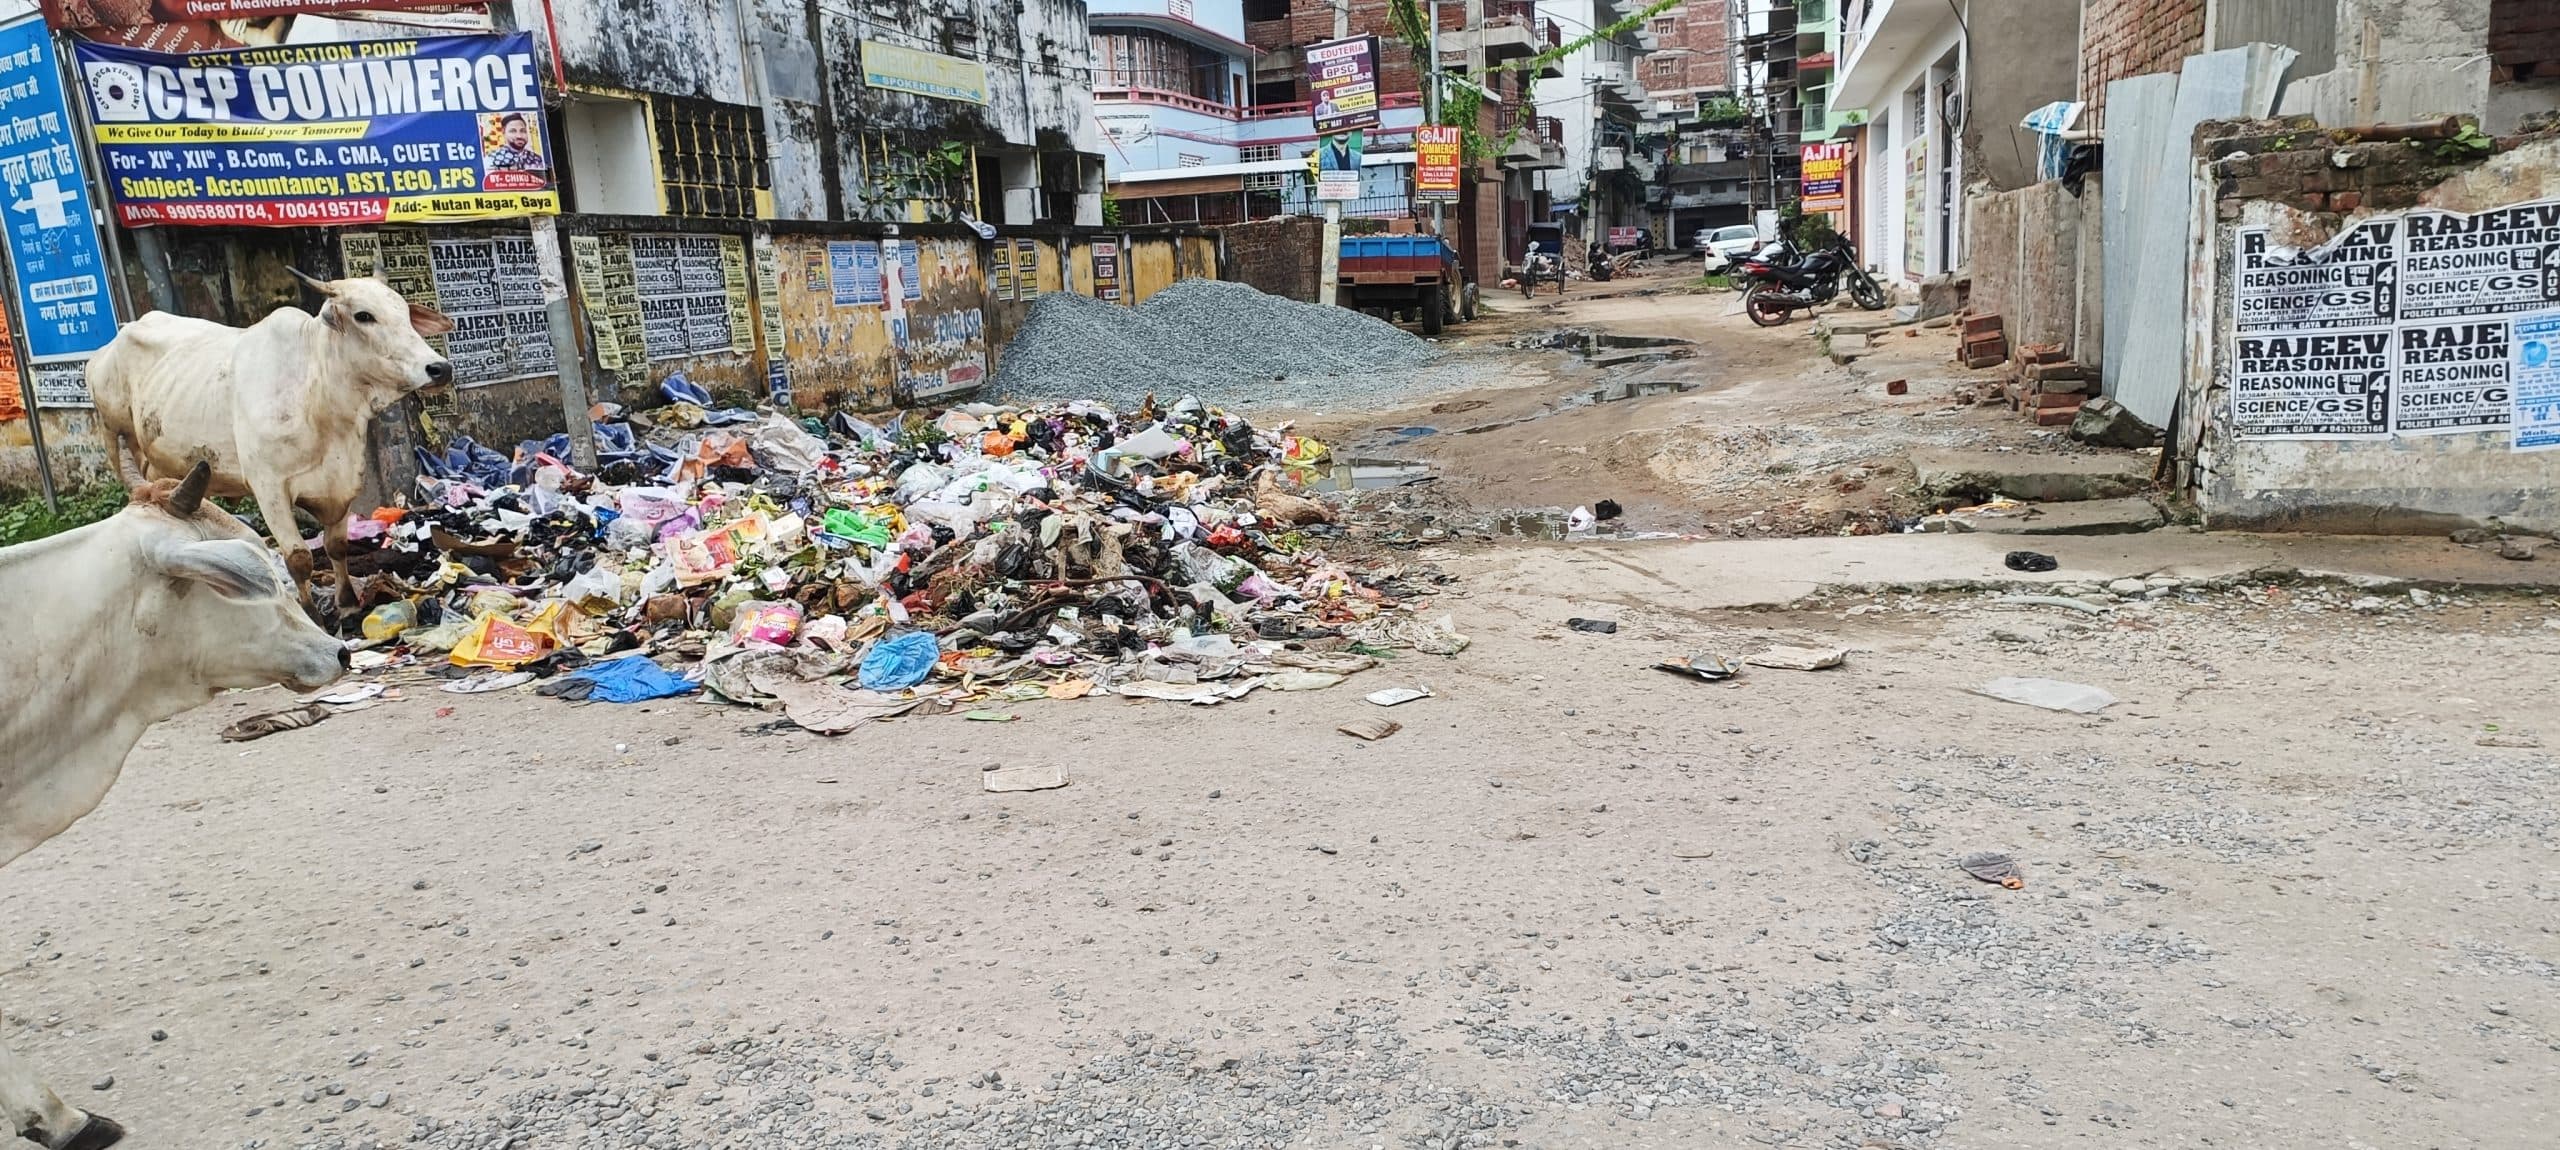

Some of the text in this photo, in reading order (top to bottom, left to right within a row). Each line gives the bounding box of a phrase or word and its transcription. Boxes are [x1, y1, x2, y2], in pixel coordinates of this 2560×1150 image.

[186, 1, 225, 15] (Near
[188, 52, 232, 68] CITY
[240, 45, 353, 66] EDUCATION
[361, 41, 418, 58] POINT
[1321, 43, 1364, 59] EDUTERIA
[1326, 64, 1355, 78] BPSC
[148, 54, 538, 121] CEP COMMERCE
[882, 76, 928, 91] SPOKEN
[38, 111, 61, 136] गया
[108, 125, 362, 139] We Give Our Today to Build your Tomorrow
[1432, 127, 1458, 144] AJIT
[1419, 143, 1458, 154] COMMERCE
[1803, 144, 1842, 161] AJIT
[28, 149, 56, 181] नगर
[52, 138, 75, 176] रोड
[110, 151, 145, 171] For-
[226, 148, 291, 170] B.Com,
[295, 147, 333, 168] C.A.
[338, 145, 389, 167] CMA,
[392, 143, 440, 163] CUET
[446, 142, 476, 162] Etc
[1425, 154, 1451, 166] CENTRE
[121, 167, 476, 200] Subject- Accountancy, BST, ECO, EPS
[125, 200, 382, 222] Mob. 9905880784, 7004195754
[432, 198, 470, 212] Nutan
[475, 196, 518, 213] Nagar,
[521, 195, 552, 210] Gaya
[2407, 205, 2560, 238] RAJEEV
[344, 240, 377, 251] ISNAA
[632, 238, 676, 249] RAJEEV
[680, 237, 720, 249] RAJEEV
[2409, 227, 2560, 253] REASONING
[431, 245, 492, 259] RAJEEV
[635, 249, 677, 258] REASONING
[682, 249, 720, 258] REASONING
[436, 258, 495, 270] REASONING
[2407, 251, 2509, 272] REASONING
[436, 271, 478, 282] REASONING
[661, 273, 675, 282] GS
[705, 272, 719, 281] GS
[2244, 268, 2342, 288] REASONING
[472, 287, 492, 297] GS
[2405, 274, 2539, 296] SCIENCE GS
[79, 300, 97, 316] गया
[641, 298, 684, 312] RAJEEV
[687, 295, 726, 309] RAJEEV
[2242, 291, 2372, 311] SCIENCE GS
[643, 310, 686, 320] REASONING
[689, 306, 727, 317] REASONING
[2403, 308, 2437, 318] POLICE
[2464, 305, 2487, 314] GAYA
[452, 314, 504, 331] AJEEV
[938, 310, 981, 343] ENGLISH
[448, 327, 506, 342] REASONING
[669, 334, 683, 343] GS
[712, 329, 726, 338] GS
[2238, 333, 2389, 359] RAJEEV
[486, 356, 504, 366] GS
[2241, 355, 2386, 374] REASONING
[2402, 363, 2503, 383] REASONING
[2239, 375, 2336, 391] REASONING
[2400, 390, 2475, 407] SCIENCE
[2483, 388, 2509, 402] G
[2238, 398, 2364, 414] SCIENCE GS
[2292, 425, 2314, 433] GAYA
[2400, 420, 2432, 429] POLICE
